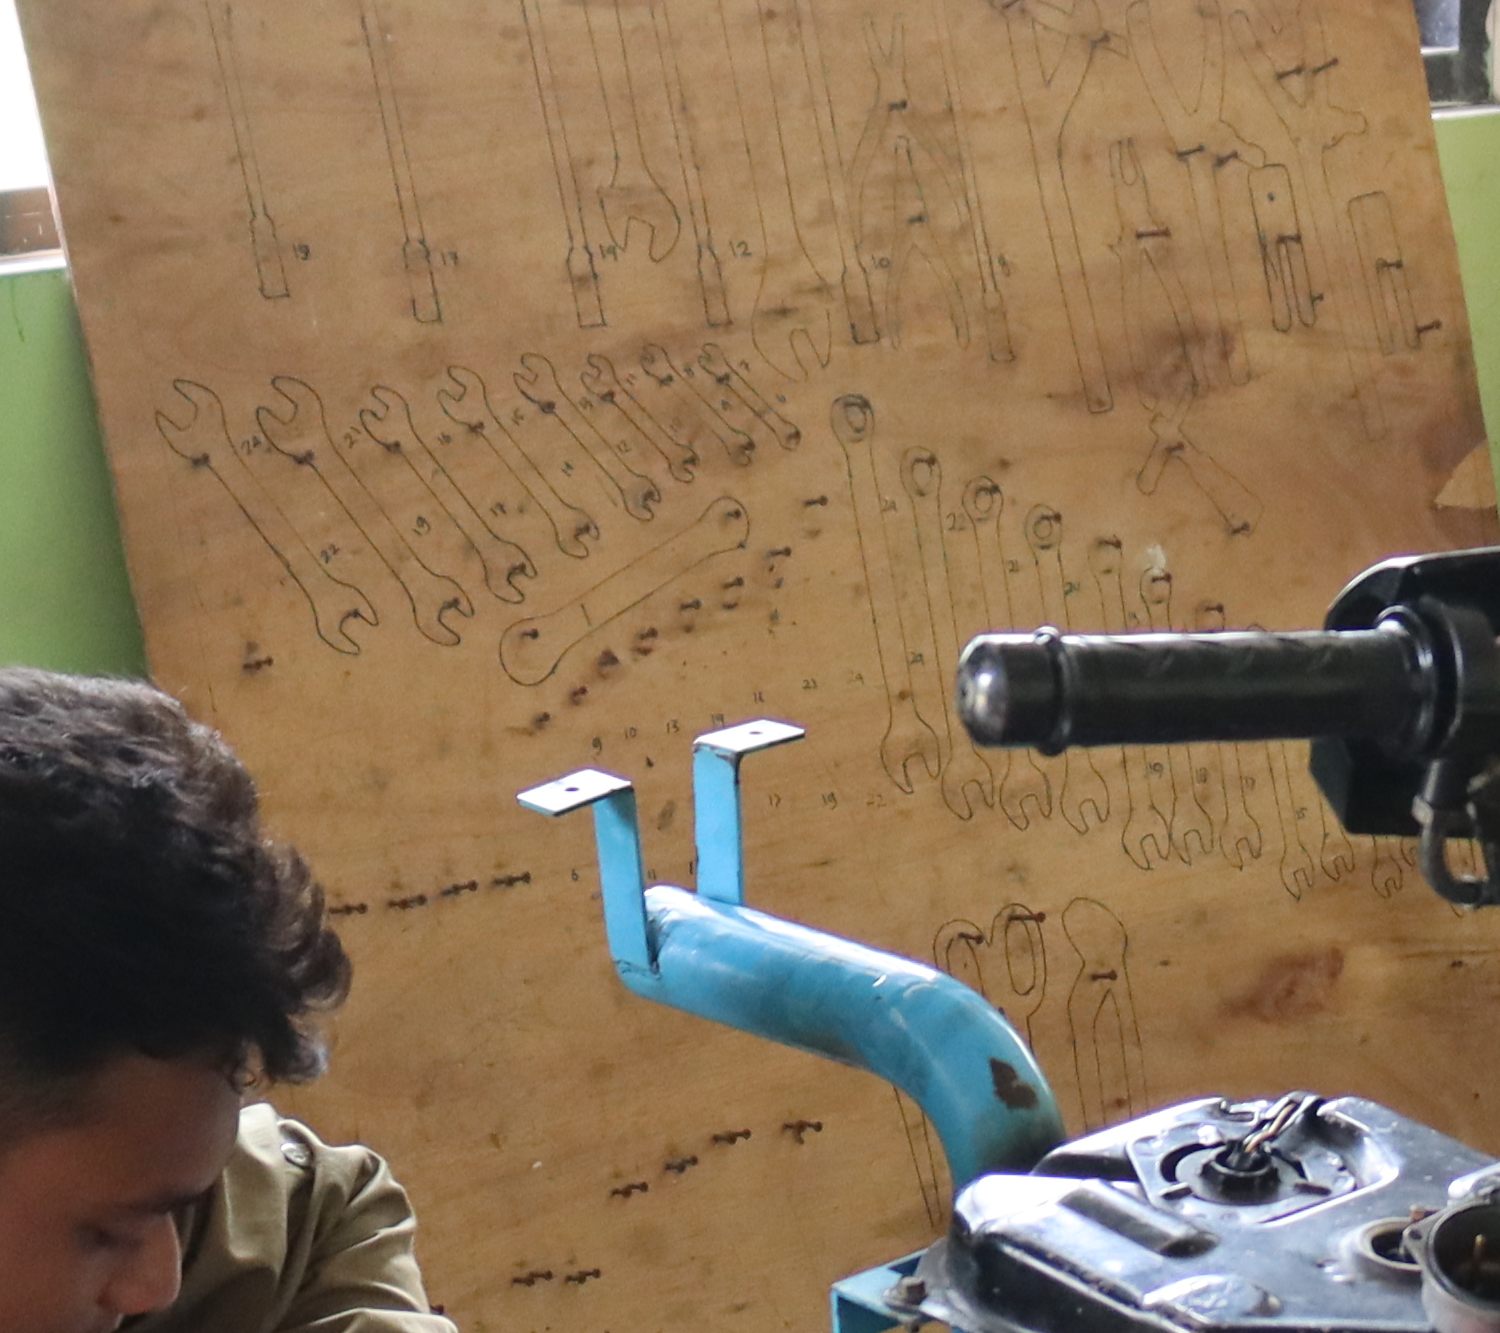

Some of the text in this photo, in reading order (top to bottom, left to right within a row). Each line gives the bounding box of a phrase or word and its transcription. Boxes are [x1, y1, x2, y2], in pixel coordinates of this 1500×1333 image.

[728, 240, 753, 258] 12
[871, 254, 891, 270] 10
[623, 727, 637, 739] 10
